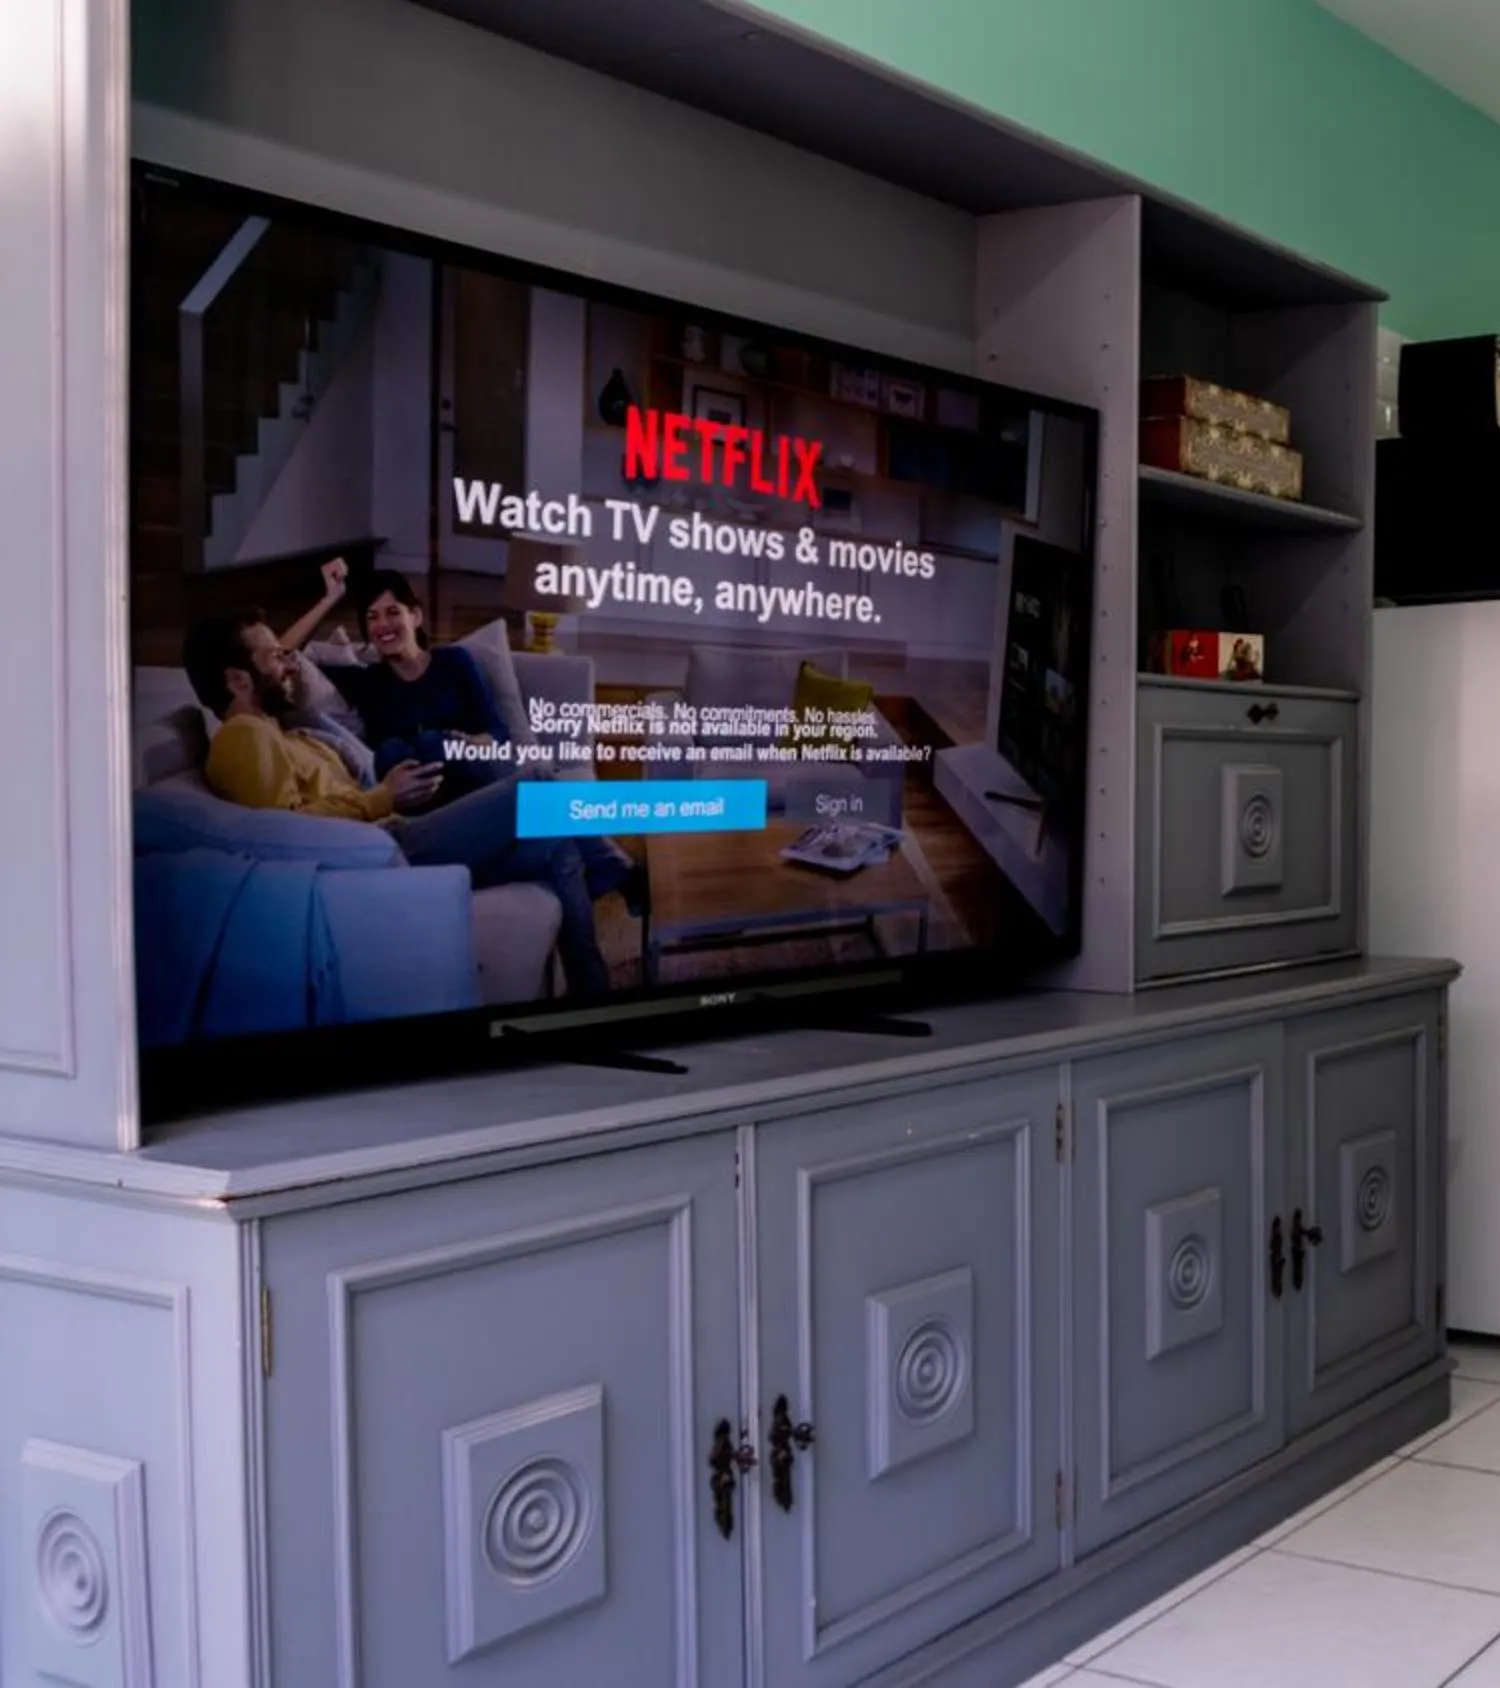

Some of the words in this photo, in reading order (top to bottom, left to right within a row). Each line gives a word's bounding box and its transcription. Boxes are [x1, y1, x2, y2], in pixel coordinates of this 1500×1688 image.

[625, 405, 824, 509] NETFLIX
[453, 477, 593, 538] Watch
[605, 499, 660, 544] TV
[669, 513, 785, 561] shows
[795, 527, 819, 565] &
[829, 538, 936, 580] movies
[534, 560, 704, 613] anytime,
[715, 579, 882, 624] anywhere.
[528, 697, 556, 720] No
[559, 702, 669, 721] commercials.
[673, 702, 698, 721] No
[701, 704, 800, 723] commitments.
[804, 706, 825, 723] No
[530, 715, 583, 738] Sorry
[587, 714, 646, 735] Netflix
[649, 716, 666, 735] is
[669, 719, 698, 736] not
[701, 718, 772, 737] available
[774, 720, 790, 737] in
[793, 723, 829, 742] your
[830, 722, 879, 742] region.
[443, 740, 512, 762] Would
[514, 746, 553, 766] you
[559, 741, 593, 762] like
[597, 743, 616, 762] to
[620, 743, 681, 762] receive
[685, 747, 706, 762] an
[710, 744, 753, 762] email
[757, 744, 798, 762] when
[801, 743, 849, 762] Netflix
[850, 744, 863, 762] is
[865, 745, 932, 763] available?
[569, 799, 618, 821] Send
[622, 803, 650, 818] me
[654, 802, 676, 817] an
[680, 797, 727, 818] email
[815, 794, 848, 817] Sign
[850, 794, 863, 813] in
[700, 992, 737, 1008] SONY
